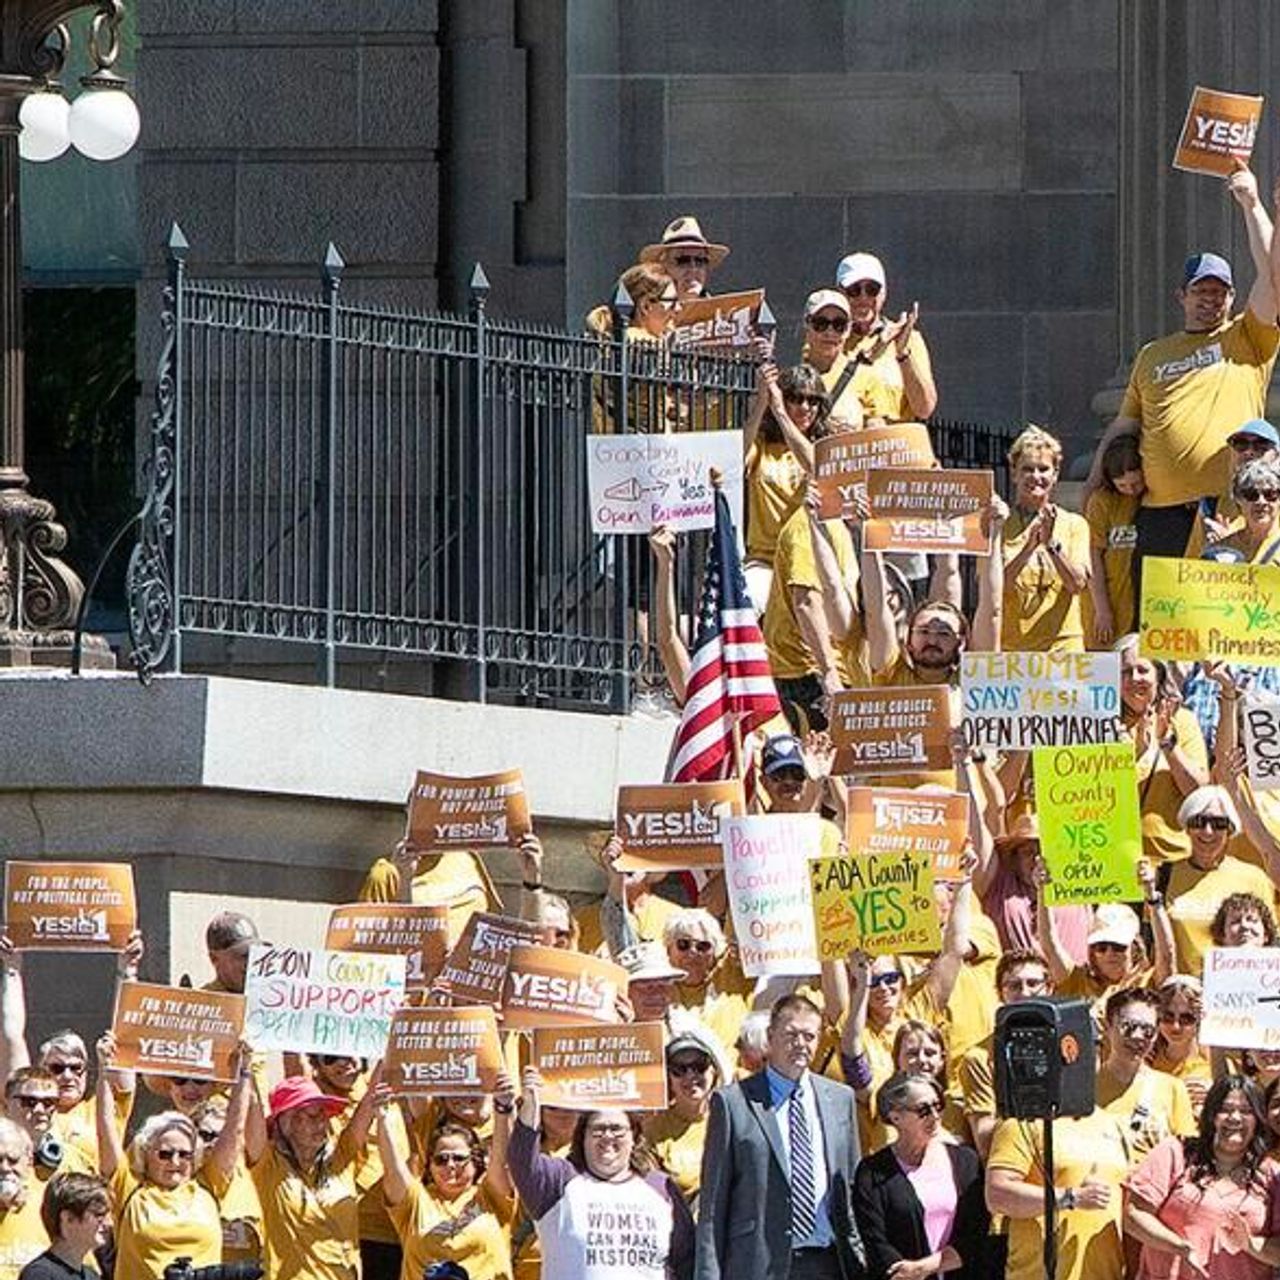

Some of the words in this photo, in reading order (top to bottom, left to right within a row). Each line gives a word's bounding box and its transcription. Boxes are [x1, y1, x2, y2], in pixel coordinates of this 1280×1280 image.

[1148, 629, 1199, 652] OPEN
[964, 654, 1094, 680] JEROME
[966, 686, 1020, 711] SAYS
[1090, 686, 1116, 711] TO
[964, 716, 1012, 746] OPEN
[851, 741, 897, 758] YES!
[1050, 786, 1117, 810] County
[434, 823, 478, 838] YES!
[624, 813, 692, 836] YES!
[1063, 824, 1108, 848] YES
[826, 859, 866, 892] ADA
[849, 888, 908, 935] YES
[911, 895, 929, 912] to
[31, 917, 81, 935] YES!
[252, 948, 311, 978] TETON
[511, 972, 578, 1000] YES!
[139, 1038, 188, 1057] YES!
[400, 1062, 448, 1080] YES!
[588, 1212, 656, 1231] WOMEN
[587, 1231, 613, 1246] CAN
